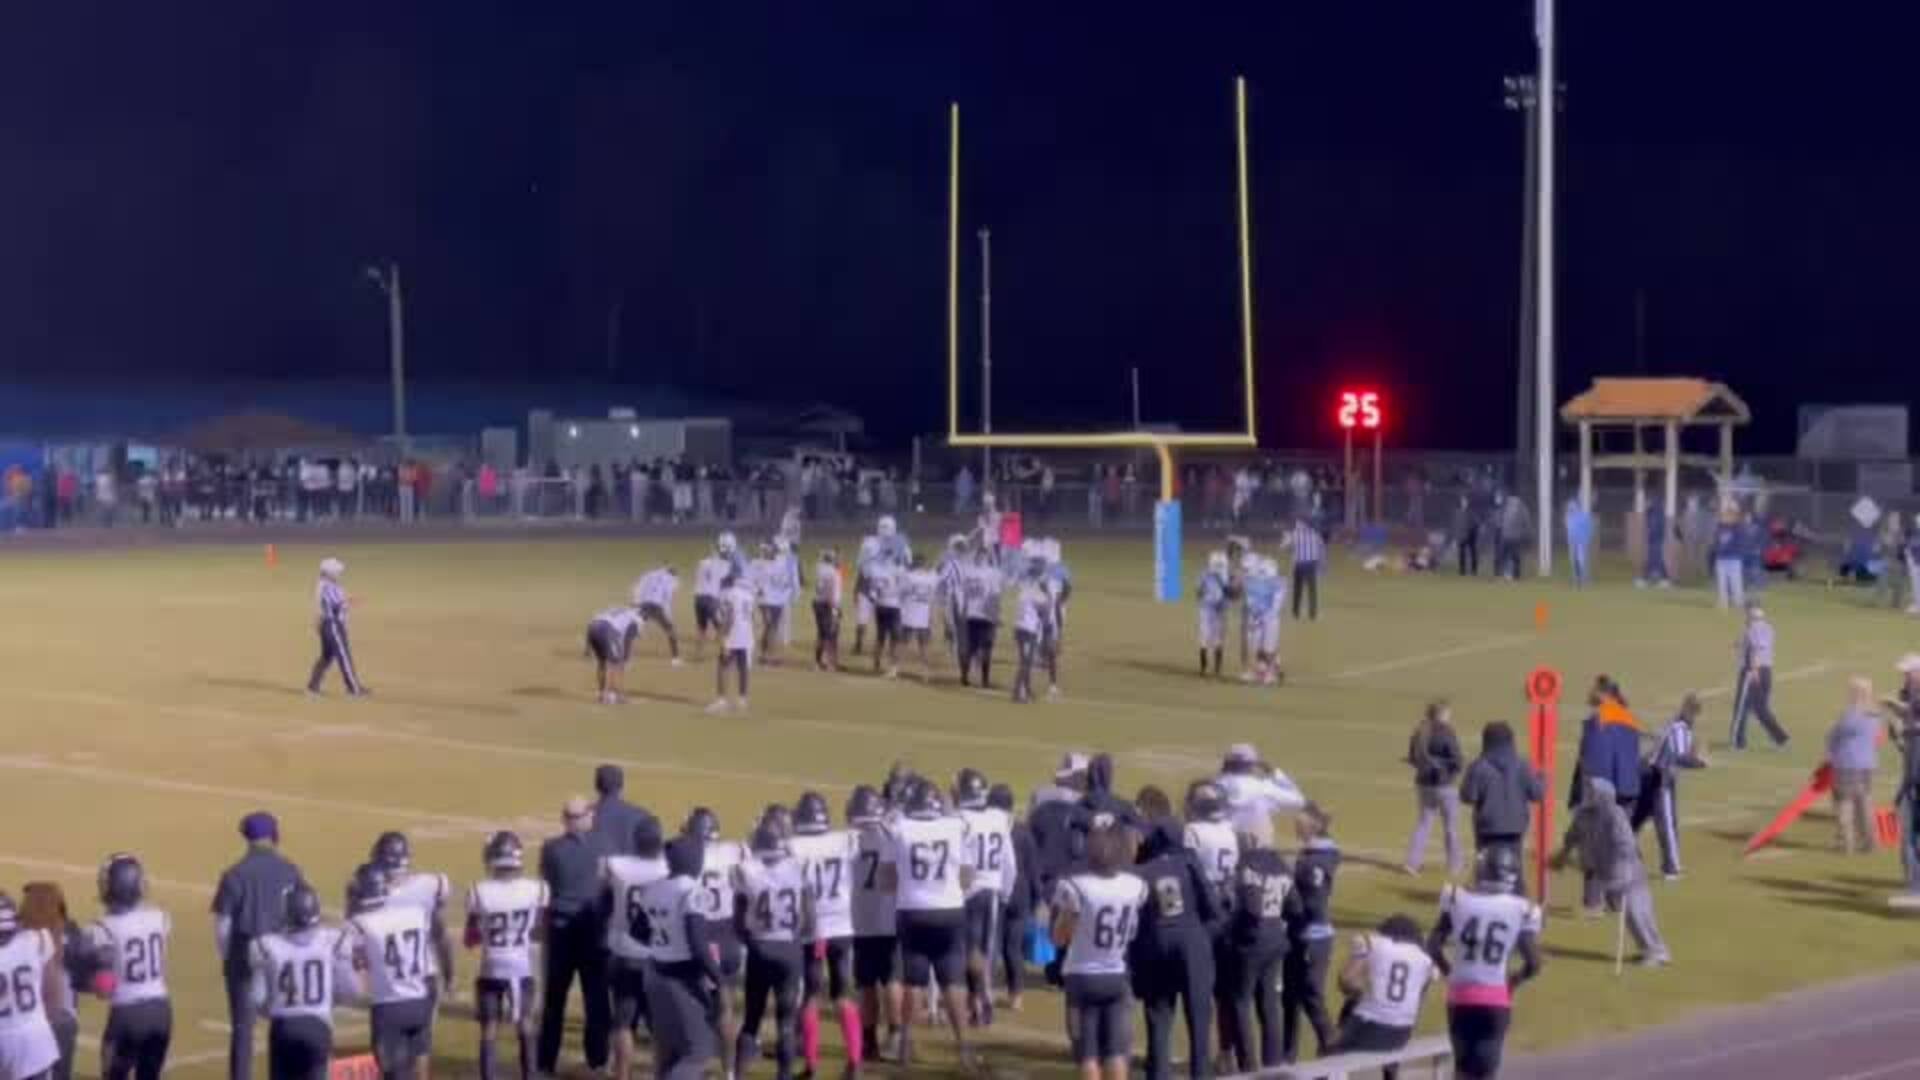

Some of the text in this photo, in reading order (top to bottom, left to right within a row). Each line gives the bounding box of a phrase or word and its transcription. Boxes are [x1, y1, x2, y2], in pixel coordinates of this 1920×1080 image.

[1338, 392, 1381, 428] 25
[910, 841, 949, 881] 67
[976, 832, 1002, 871] 12
[488, 908, 530, 948] 27
[755, 887, 798, 932] 43
[1094, 904, 1138, 949] 64
[125, 931, 164, 984] 20
[384, 928, 422, 981] 47
[1460, 916, 1509, 965] 46
[278, 958, 324, 1007] 40
[1386, 961, 1409, 1003] 8
